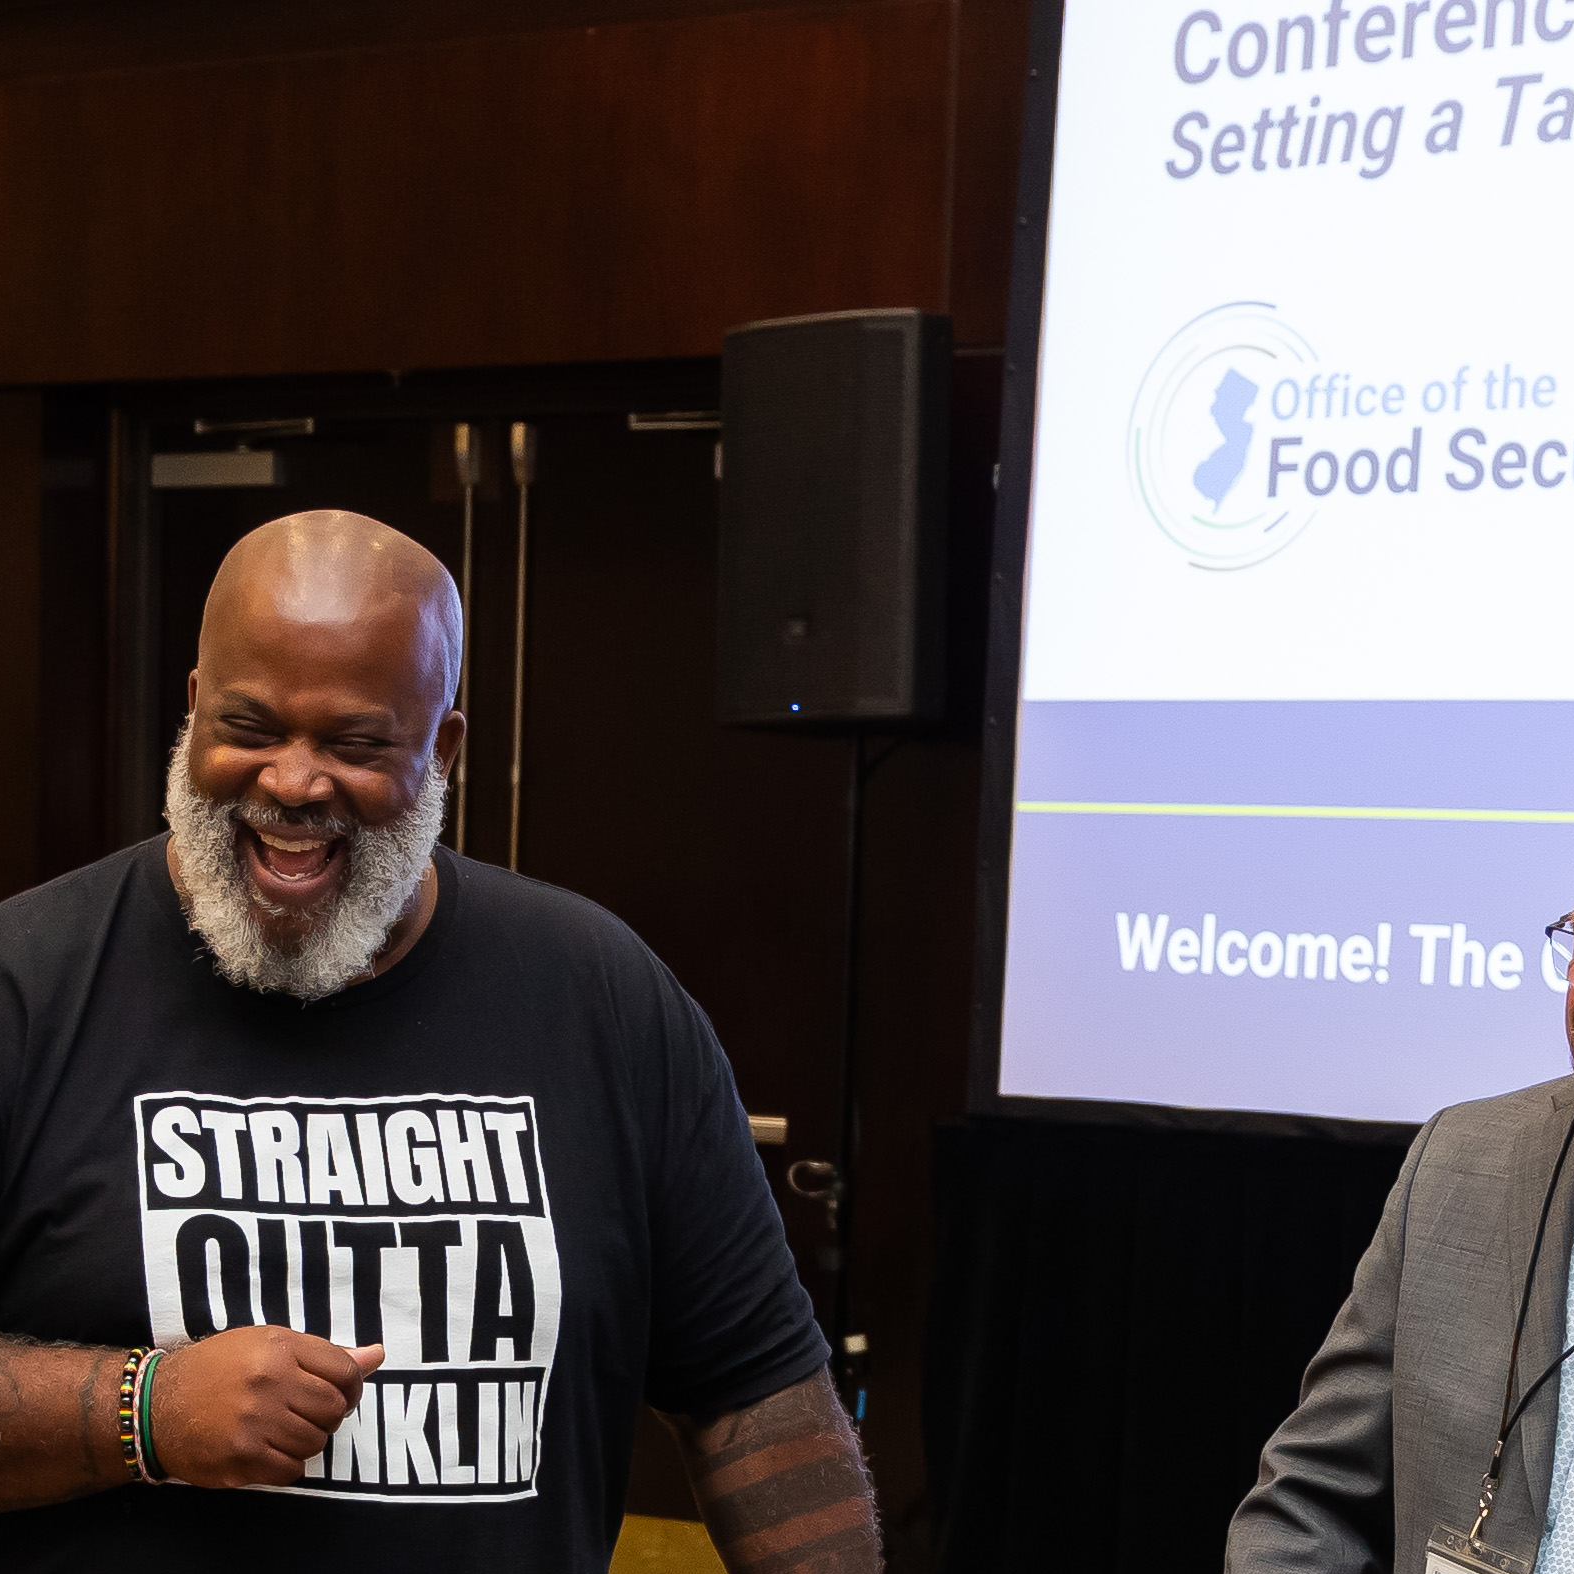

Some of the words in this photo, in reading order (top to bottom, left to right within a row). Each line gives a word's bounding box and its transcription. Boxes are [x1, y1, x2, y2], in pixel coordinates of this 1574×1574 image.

[1165, 95, 1404, 180] Setting
[1425, 100, 1463, 154] a
[1271, 372, 1405, 421] Office
[1422, 365, 1471, 413] of
[1483, 363, 1558, 411] the
[1266, 425, 1424, 499] Food
[1117, 913, 1392, 983] Welcome!
[1409, 923, 1524, 990] The
[151, 1105, 530, 1206] STRAIGHT
[176, 1213, 536, 1364] OUTTA
[305, 1381, 536, 1485] NKLIN
